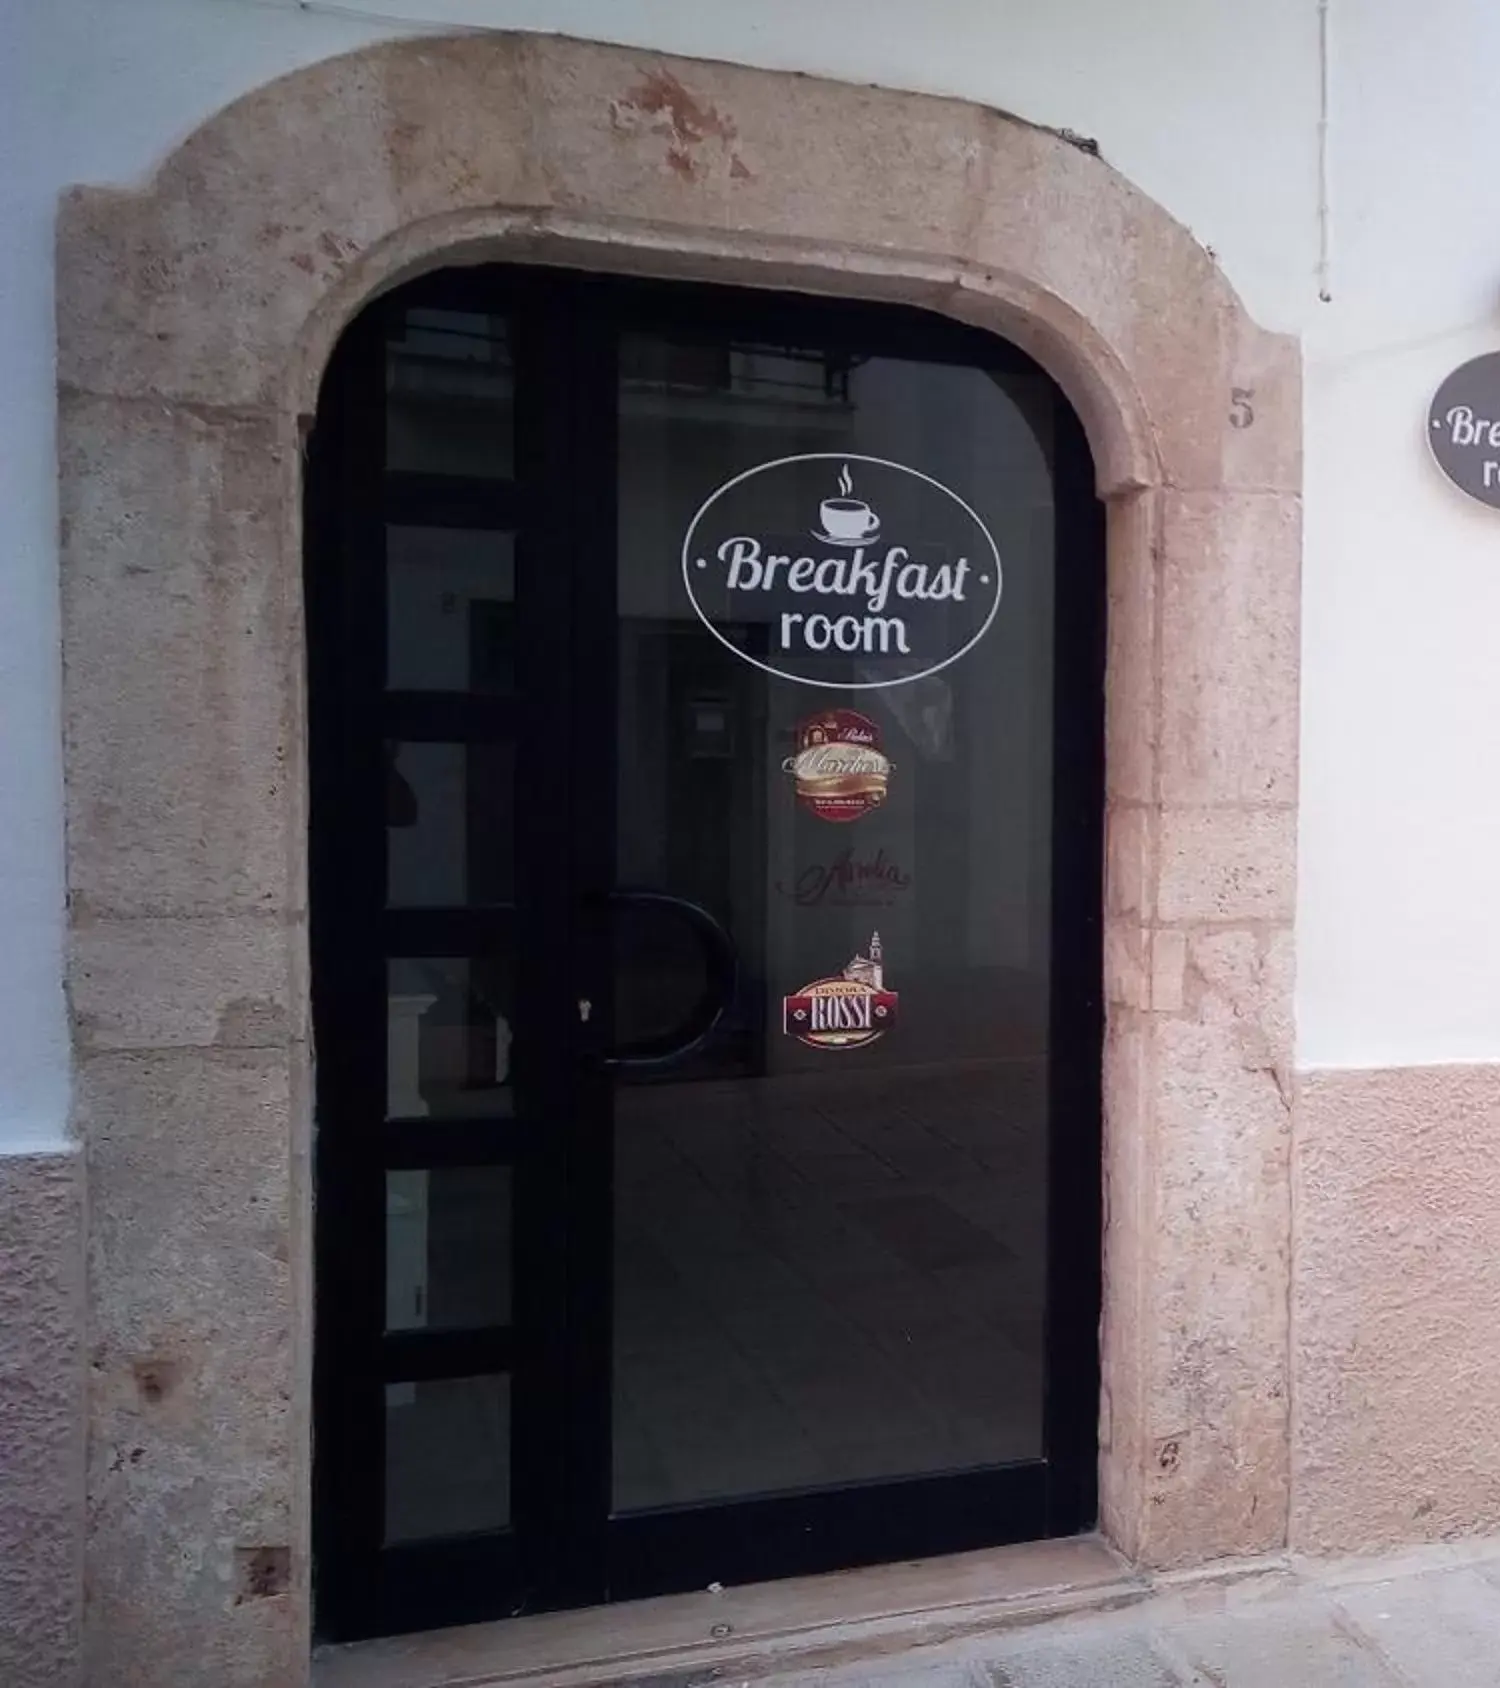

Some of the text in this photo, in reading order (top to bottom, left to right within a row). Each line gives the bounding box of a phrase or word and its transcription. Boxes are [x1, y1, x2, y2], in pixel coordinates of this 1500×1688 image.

[1228, 386, 1256, 429] 5
[717, 535, 971, 612] Breakfast
[780, 612, 911, 654] room
[810, 995, 872, 1030] ROSSI
